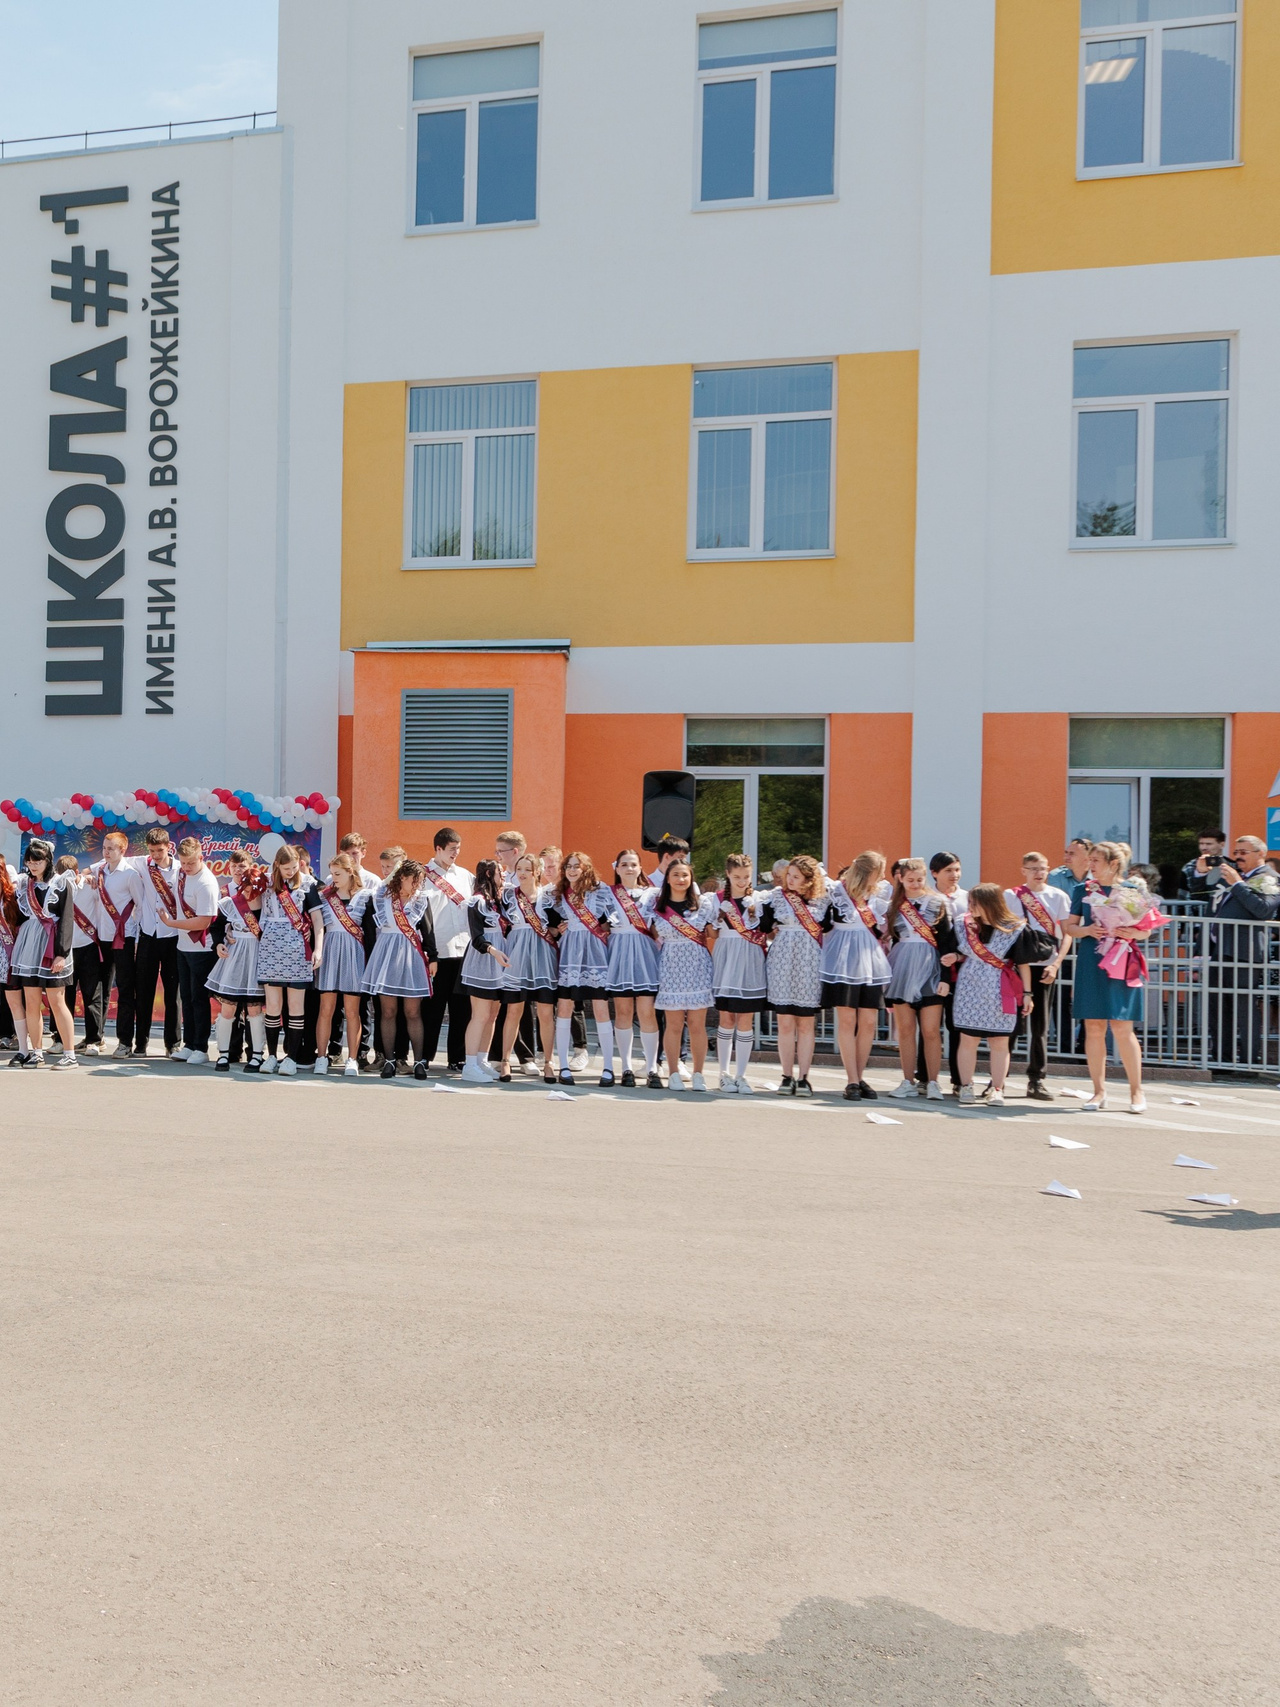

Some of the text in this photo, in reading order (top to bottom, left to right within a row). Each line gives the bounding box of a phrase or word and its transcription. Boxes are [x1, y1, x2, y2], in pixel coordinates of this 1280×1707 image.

[45, 336, 127, 716] ШКОЛА
[142, 181, 180, 715] ИМЕНИ А.В. ВОРОЖЕЙКИНА
[200, 834, 241, 856] брый
